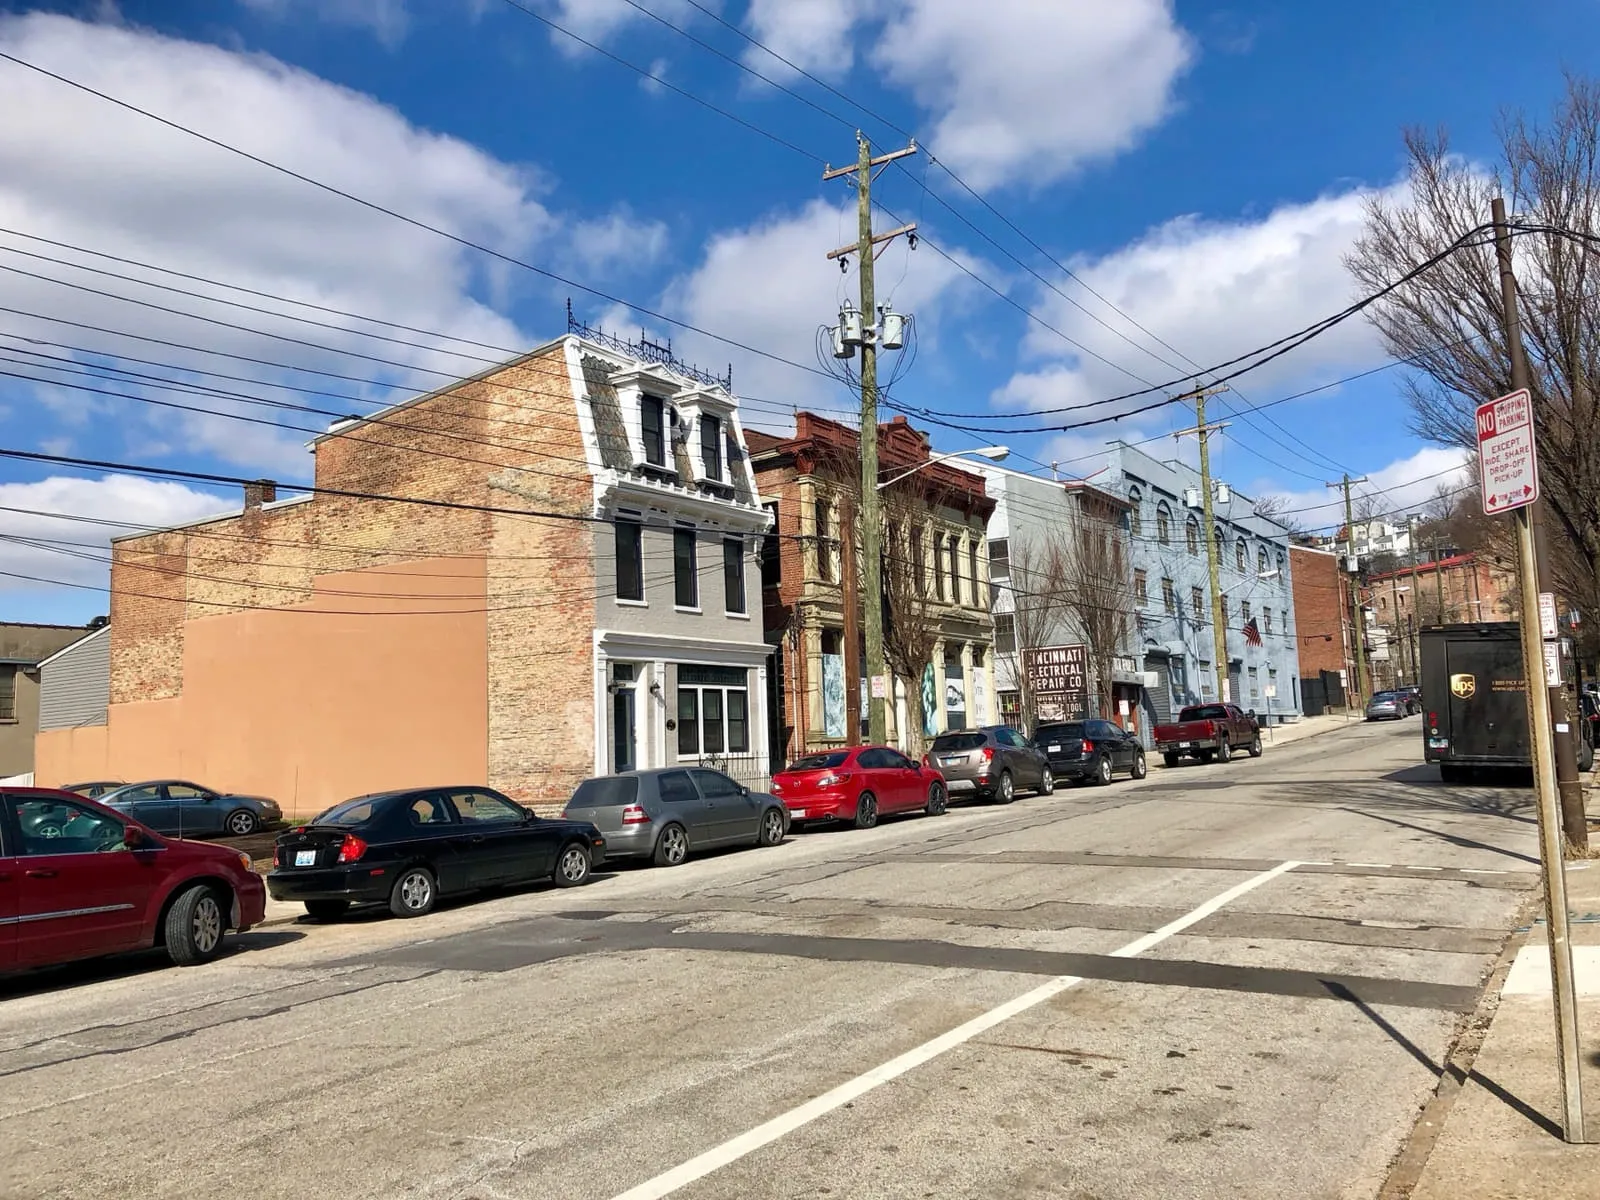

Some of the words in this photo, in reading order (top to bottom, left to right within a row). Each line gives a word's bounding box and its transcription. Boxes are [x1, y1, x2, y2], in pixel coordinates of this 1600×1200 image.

[1478, 411, 1494, 434] NO
[1499, 411, 1526, 430] PARKING
[1491, 437, 1521, 454] EXCEPT
[1485, 453, 1500, 466] RIDE
[1504, 444, 1530, 460] SHARE
[1489, 457, 1526, 475] DROP-OFF
[1494, 469, 1523, 484] PICK-UP
[1030, 677, 1065, 690] REPAIR
[1454, 681, 1474, 695] ups
